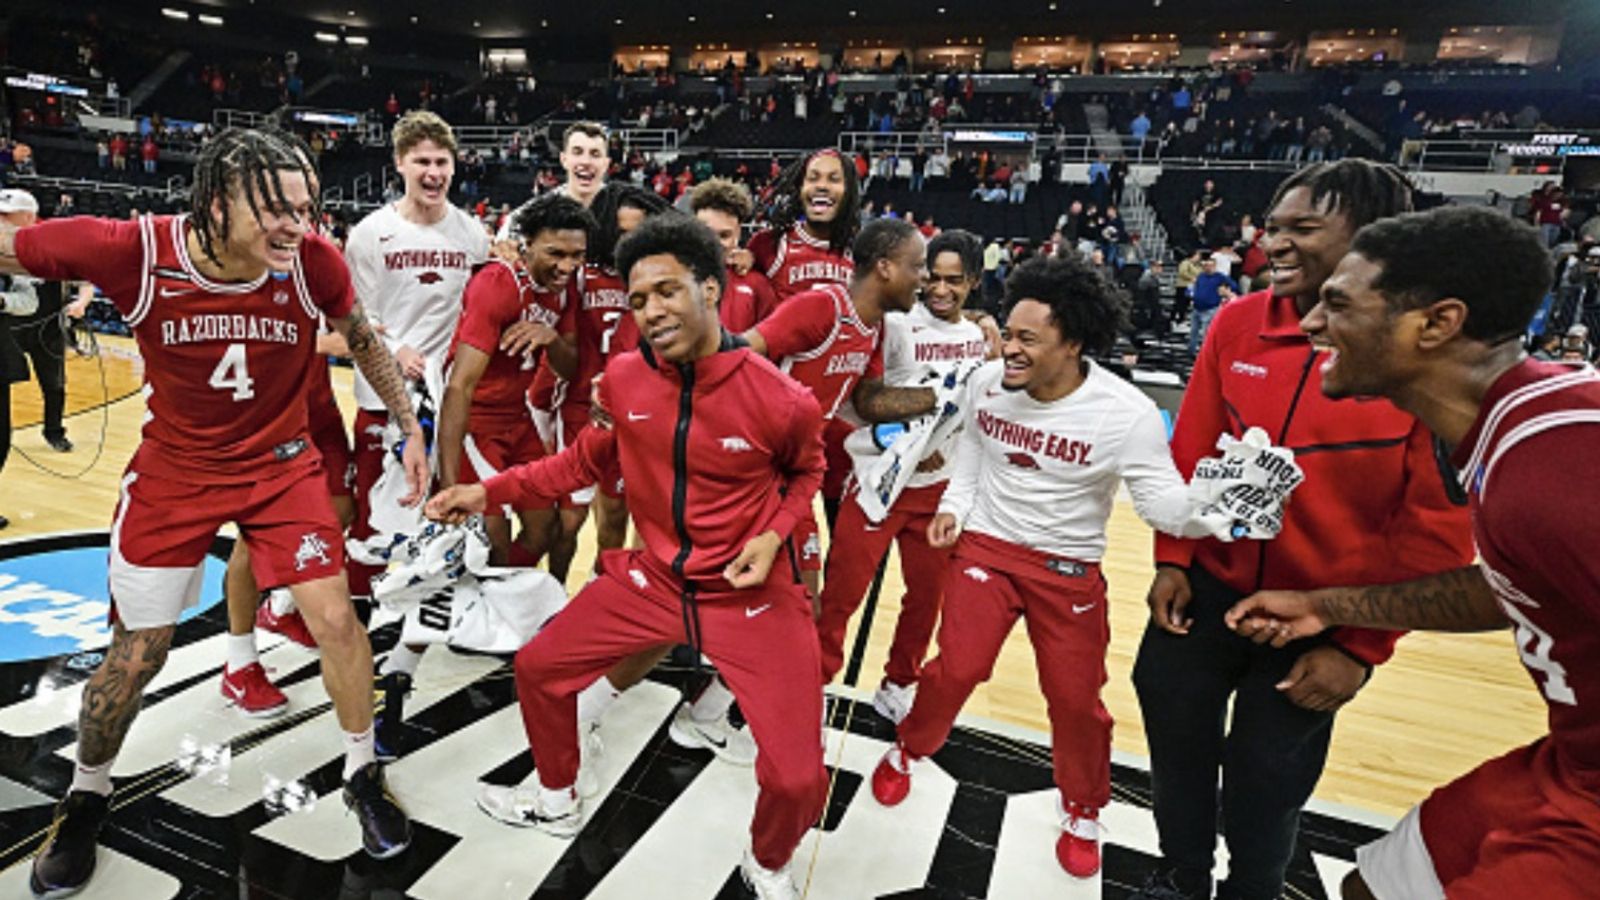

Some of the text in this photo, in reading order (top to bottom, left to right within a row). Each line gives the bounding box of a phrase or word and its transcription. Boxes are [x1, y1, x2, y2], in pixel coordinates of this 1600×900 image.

[161, 314, 299, 345] RAZORBACKS
[602, 311, 622, 354] 7
[208, 343, 255, 402] 4
[977, 409, 1045, 454] NOTHING
